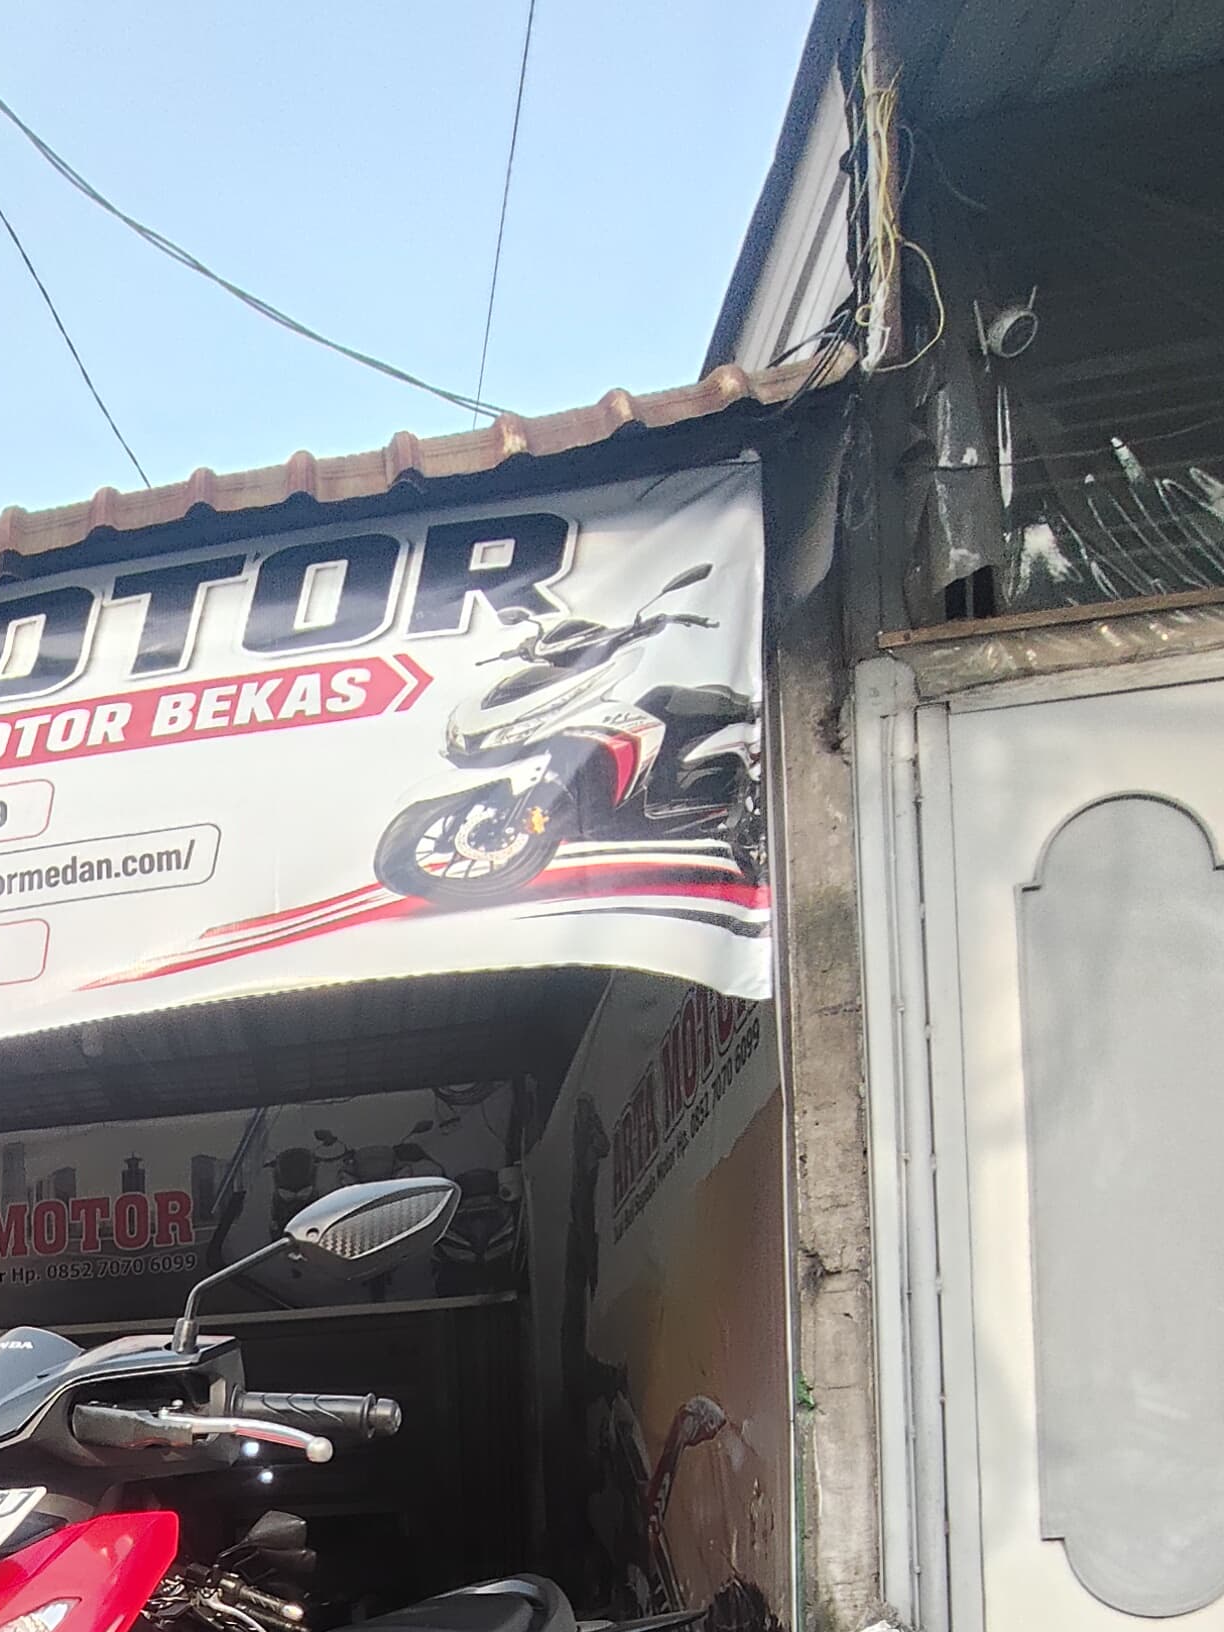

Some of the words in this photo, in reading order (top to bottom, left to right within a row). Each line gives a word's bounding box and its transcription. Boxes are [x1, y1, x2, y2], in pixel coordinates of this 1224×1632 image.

[150, 667, 373, 737] BEKAS
[11, 1266, 42, 1287] Hp.
[46, 1262, 94, 1280] 0852
[97, 1259, 144, 1278] 7070
[149, 1253, 197, 1273] 6099
